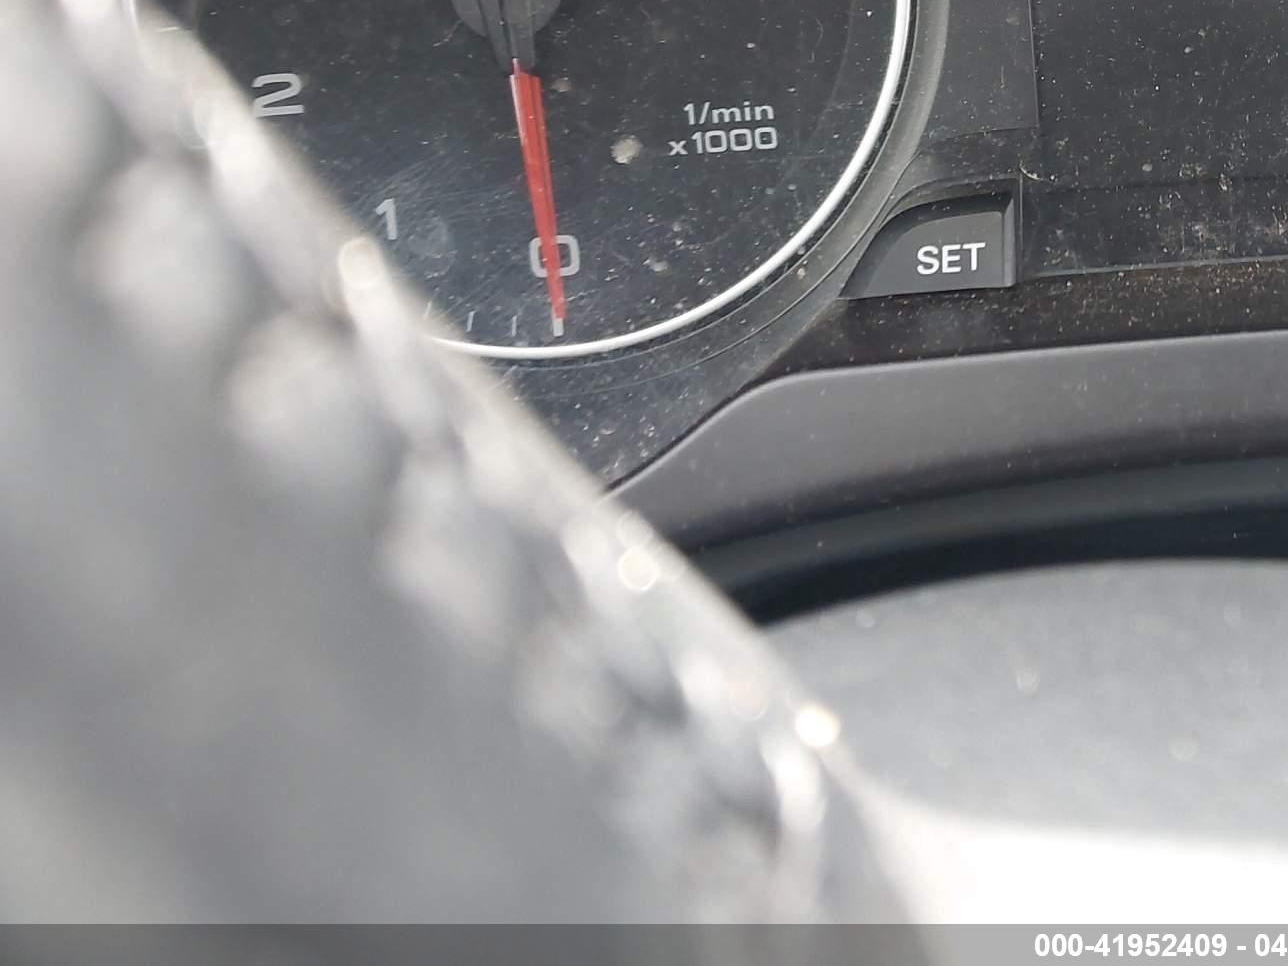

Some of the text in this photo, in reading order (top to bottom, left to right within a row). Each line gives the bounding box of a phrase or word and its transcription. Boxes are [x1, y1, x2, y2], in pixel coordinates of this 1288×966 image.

[253, 73, 304, 117] 2
[683, 102, 774, 125] 1/min
[668, 126, 777, 155] x1000
[376, 199, 398, 240] 1
[528, 235, 581, 278] 0
[916, 242, 985, 275] SET
